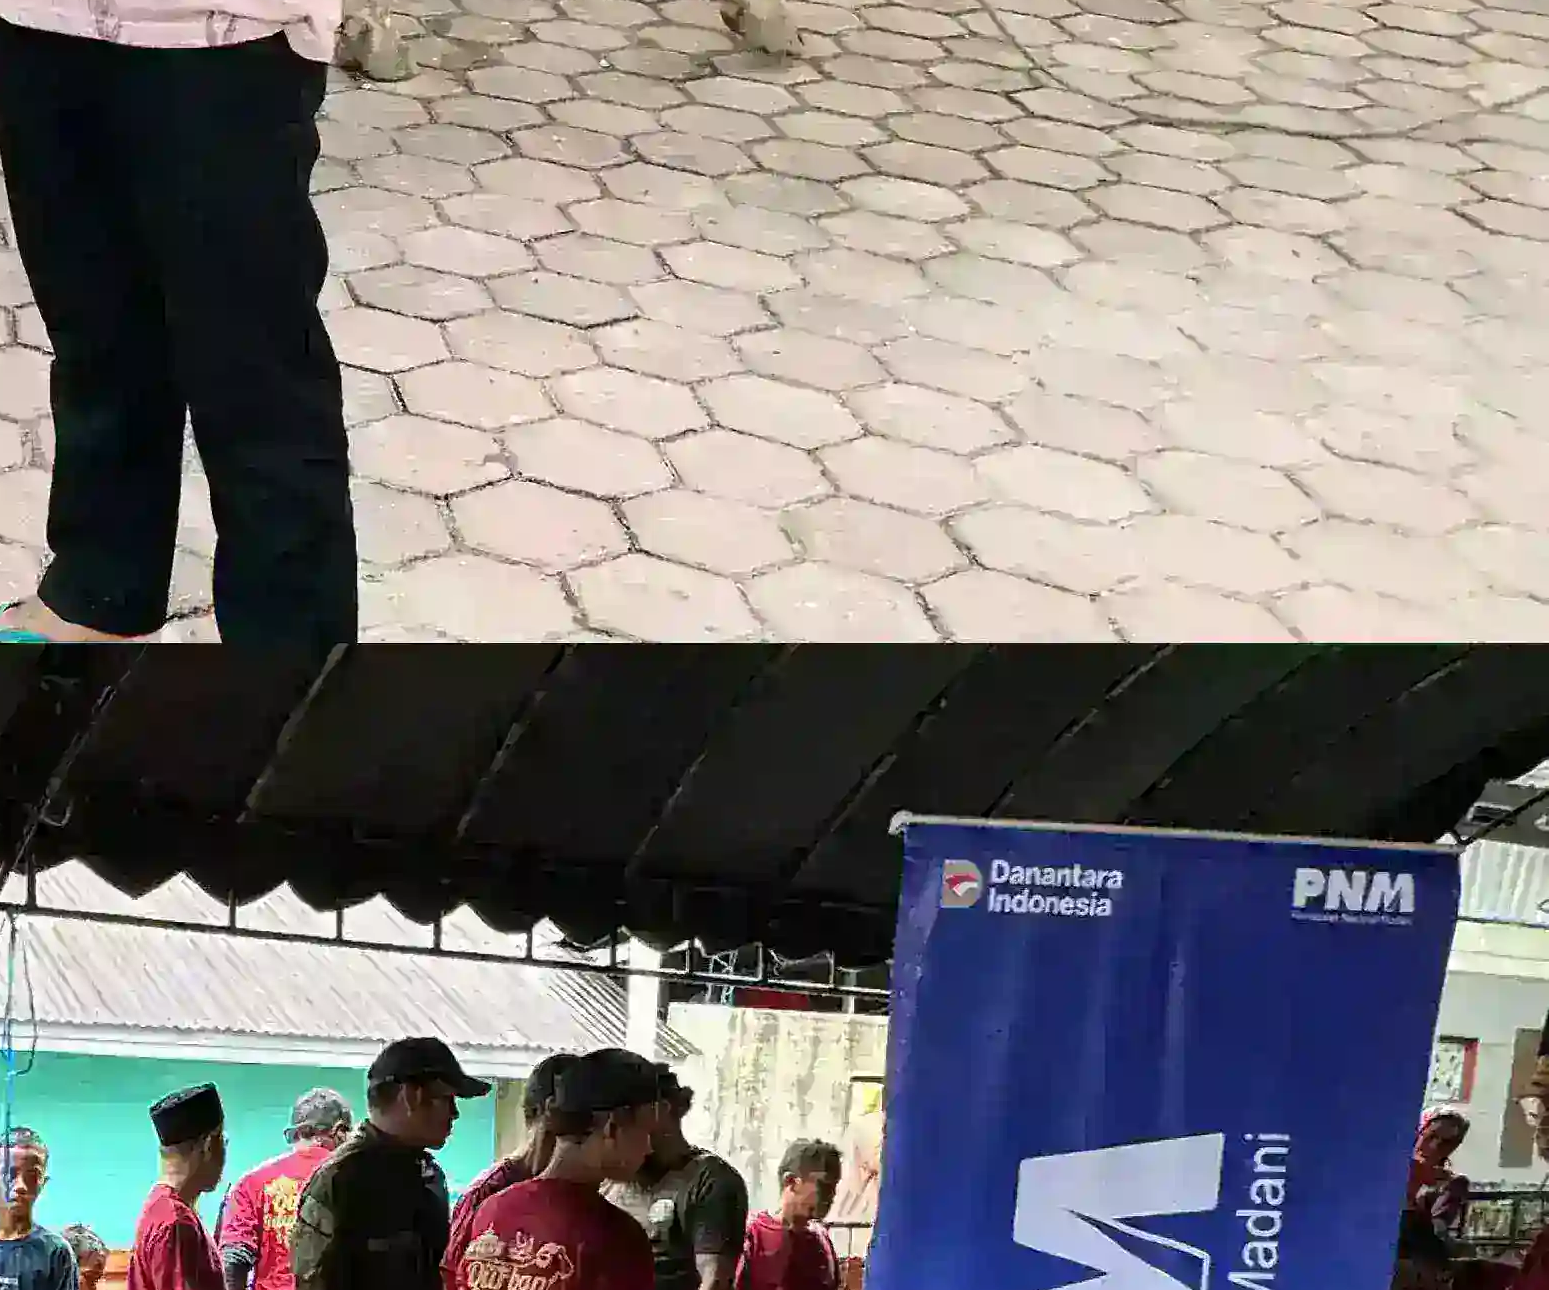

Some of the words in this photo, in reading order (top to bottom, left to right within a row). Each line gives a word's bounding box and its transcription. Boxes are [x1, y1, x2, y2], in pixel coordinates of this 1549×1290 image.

[991, 859, 1124, 889] Danantara
[987, 886, 1113, 916] Indonesia
[1293, 867, 1415, 913] PNM
